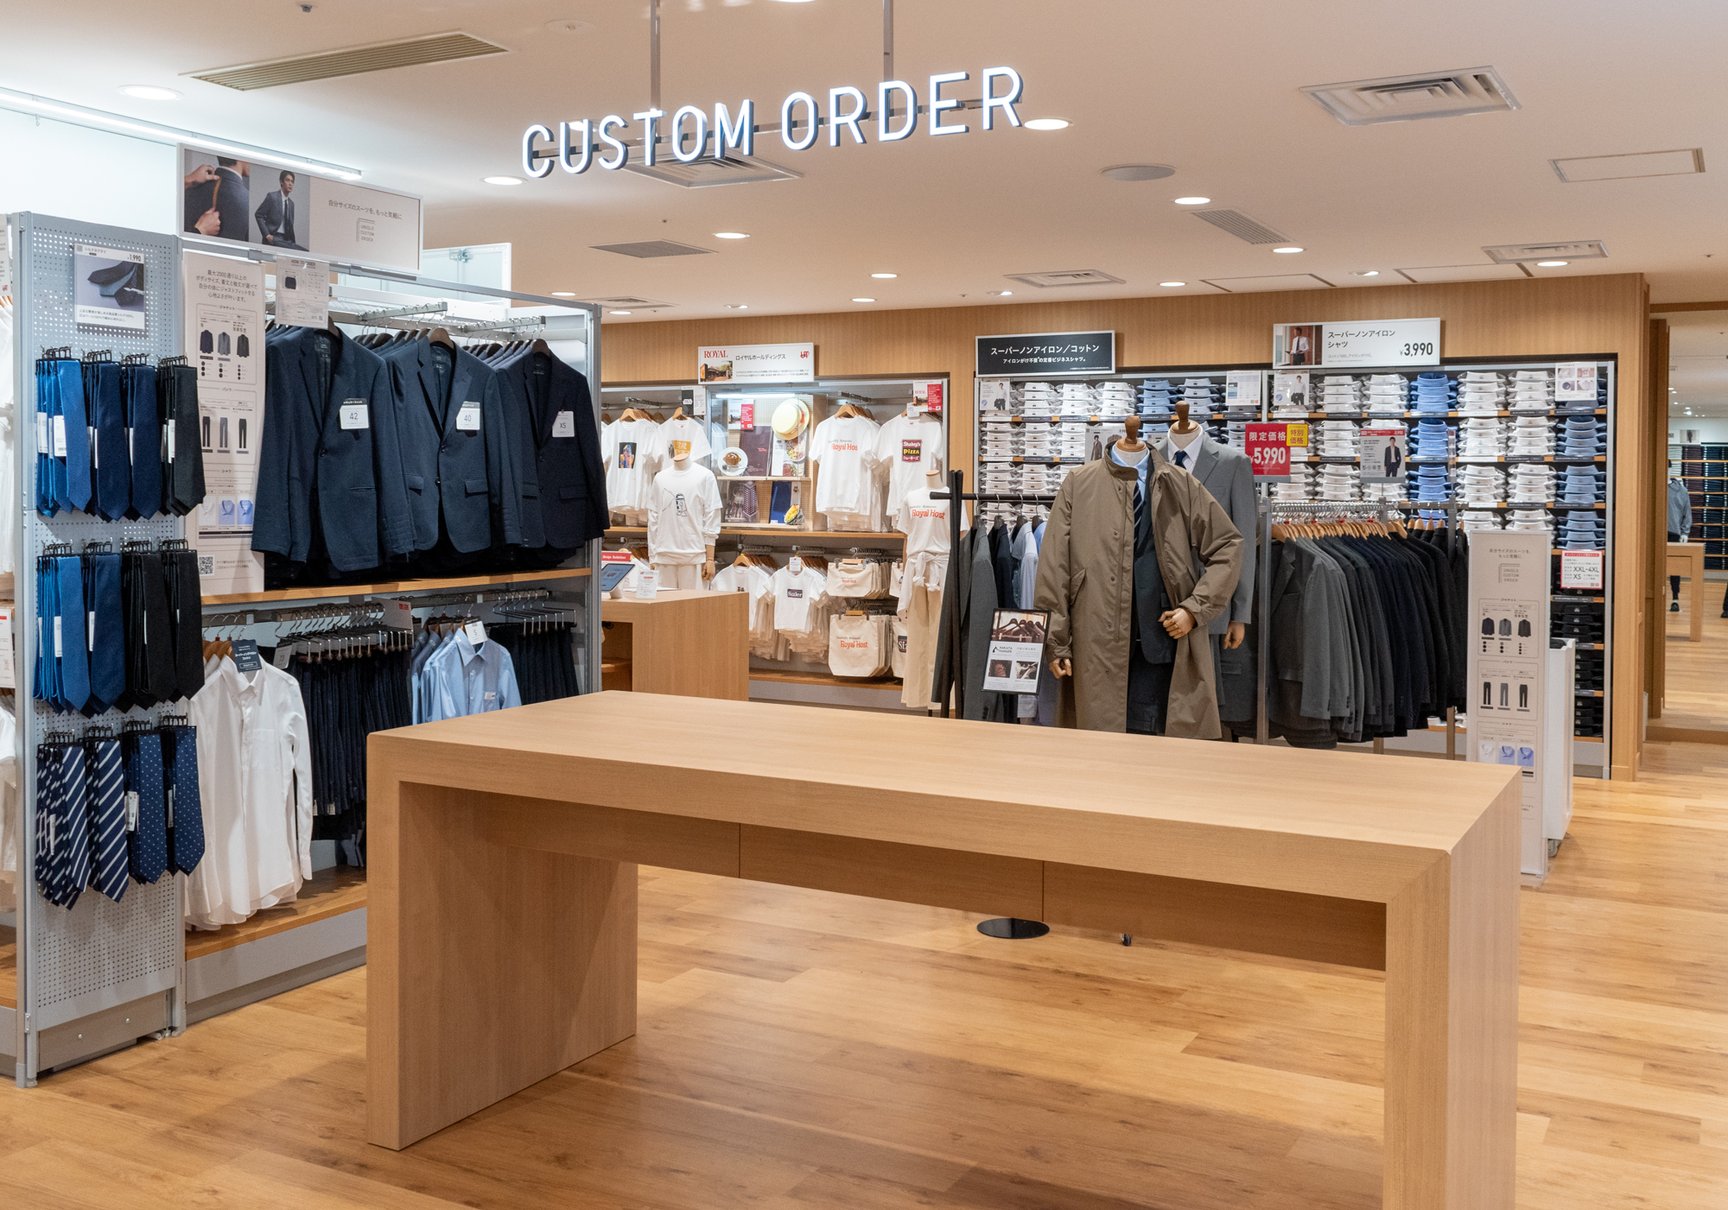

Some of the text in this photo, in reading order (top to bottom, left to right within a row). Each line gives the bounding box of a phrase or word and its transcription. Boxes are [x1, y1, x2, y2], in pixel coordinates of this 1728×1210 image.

[521, 65, 1024, 179] CUSTOM ORDER
[1328, 330, 1396, 339] スーパーノンアイロン
[1328, 341, 1348, 349] シャツ
[704, 350, 728, 359] ROYAL
[1249, 431, 1286, 442] 限定価格
[912, 509, 945, 520] Royal Host
[840, 640, 868, 649] Royal Host
